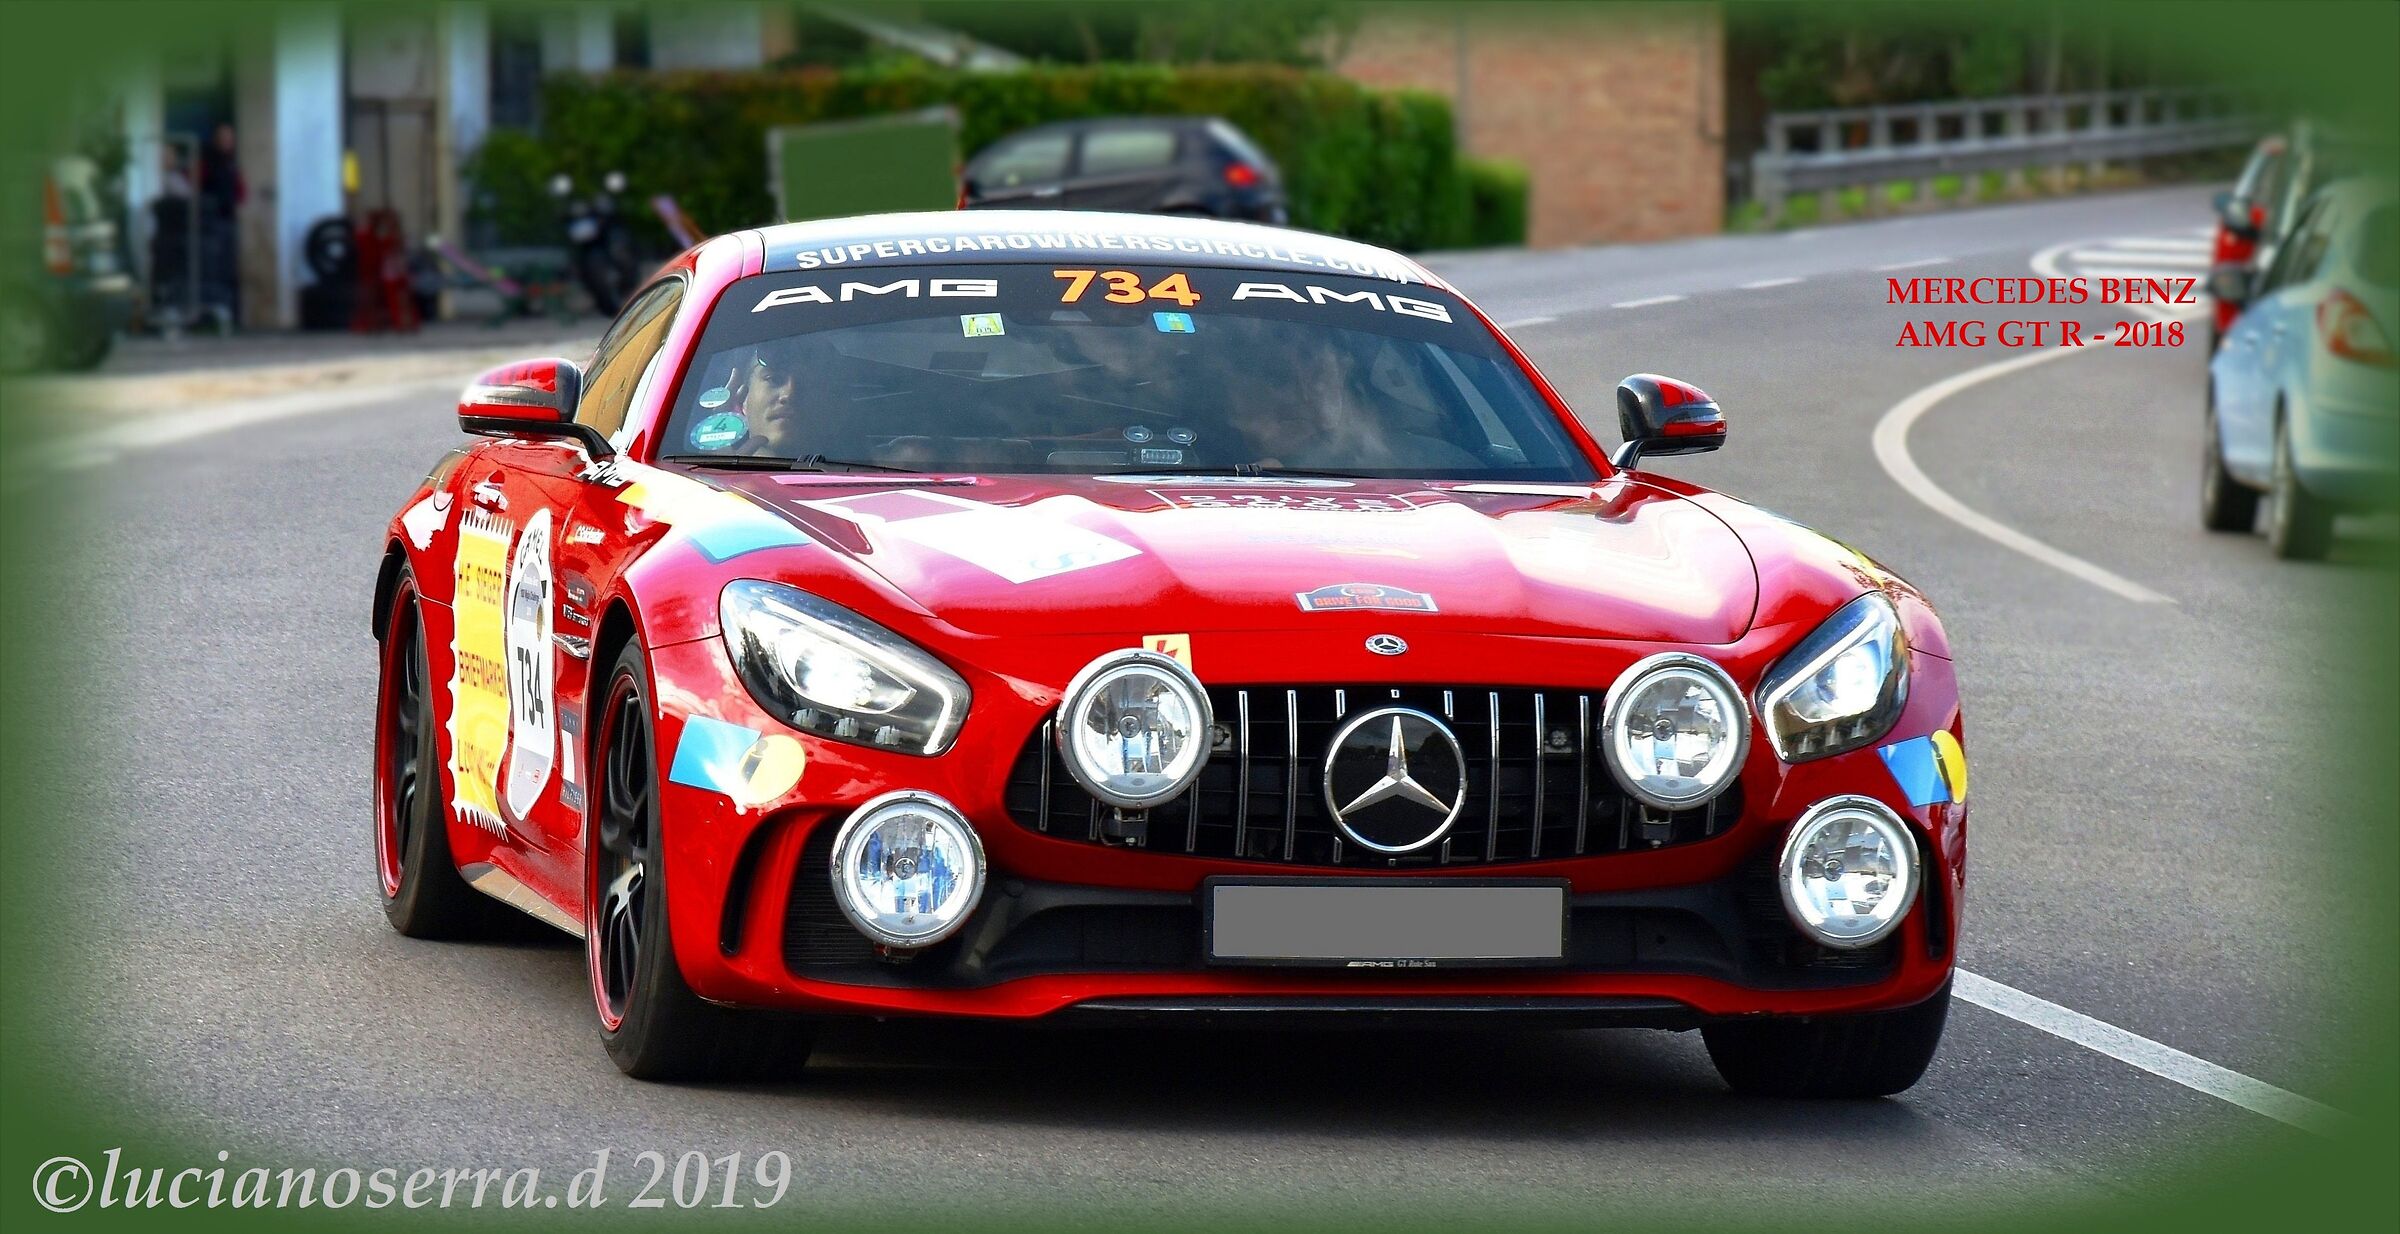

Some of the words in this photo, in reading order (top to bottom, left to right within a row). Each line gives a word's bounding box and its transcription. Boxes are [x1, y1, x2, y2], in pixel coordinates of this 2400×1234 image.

[796, 232, 1409, 285] SUPERCAROWNERSCIRCLE.COM
[752, 278, 998, 314] AMG
[1052, 268, 1201, 307] 734
[1231, 281, 1453, 324] AMG
[1314, 596, 1353, 607] DRIVE
[517, 646, 544, 730] 734
